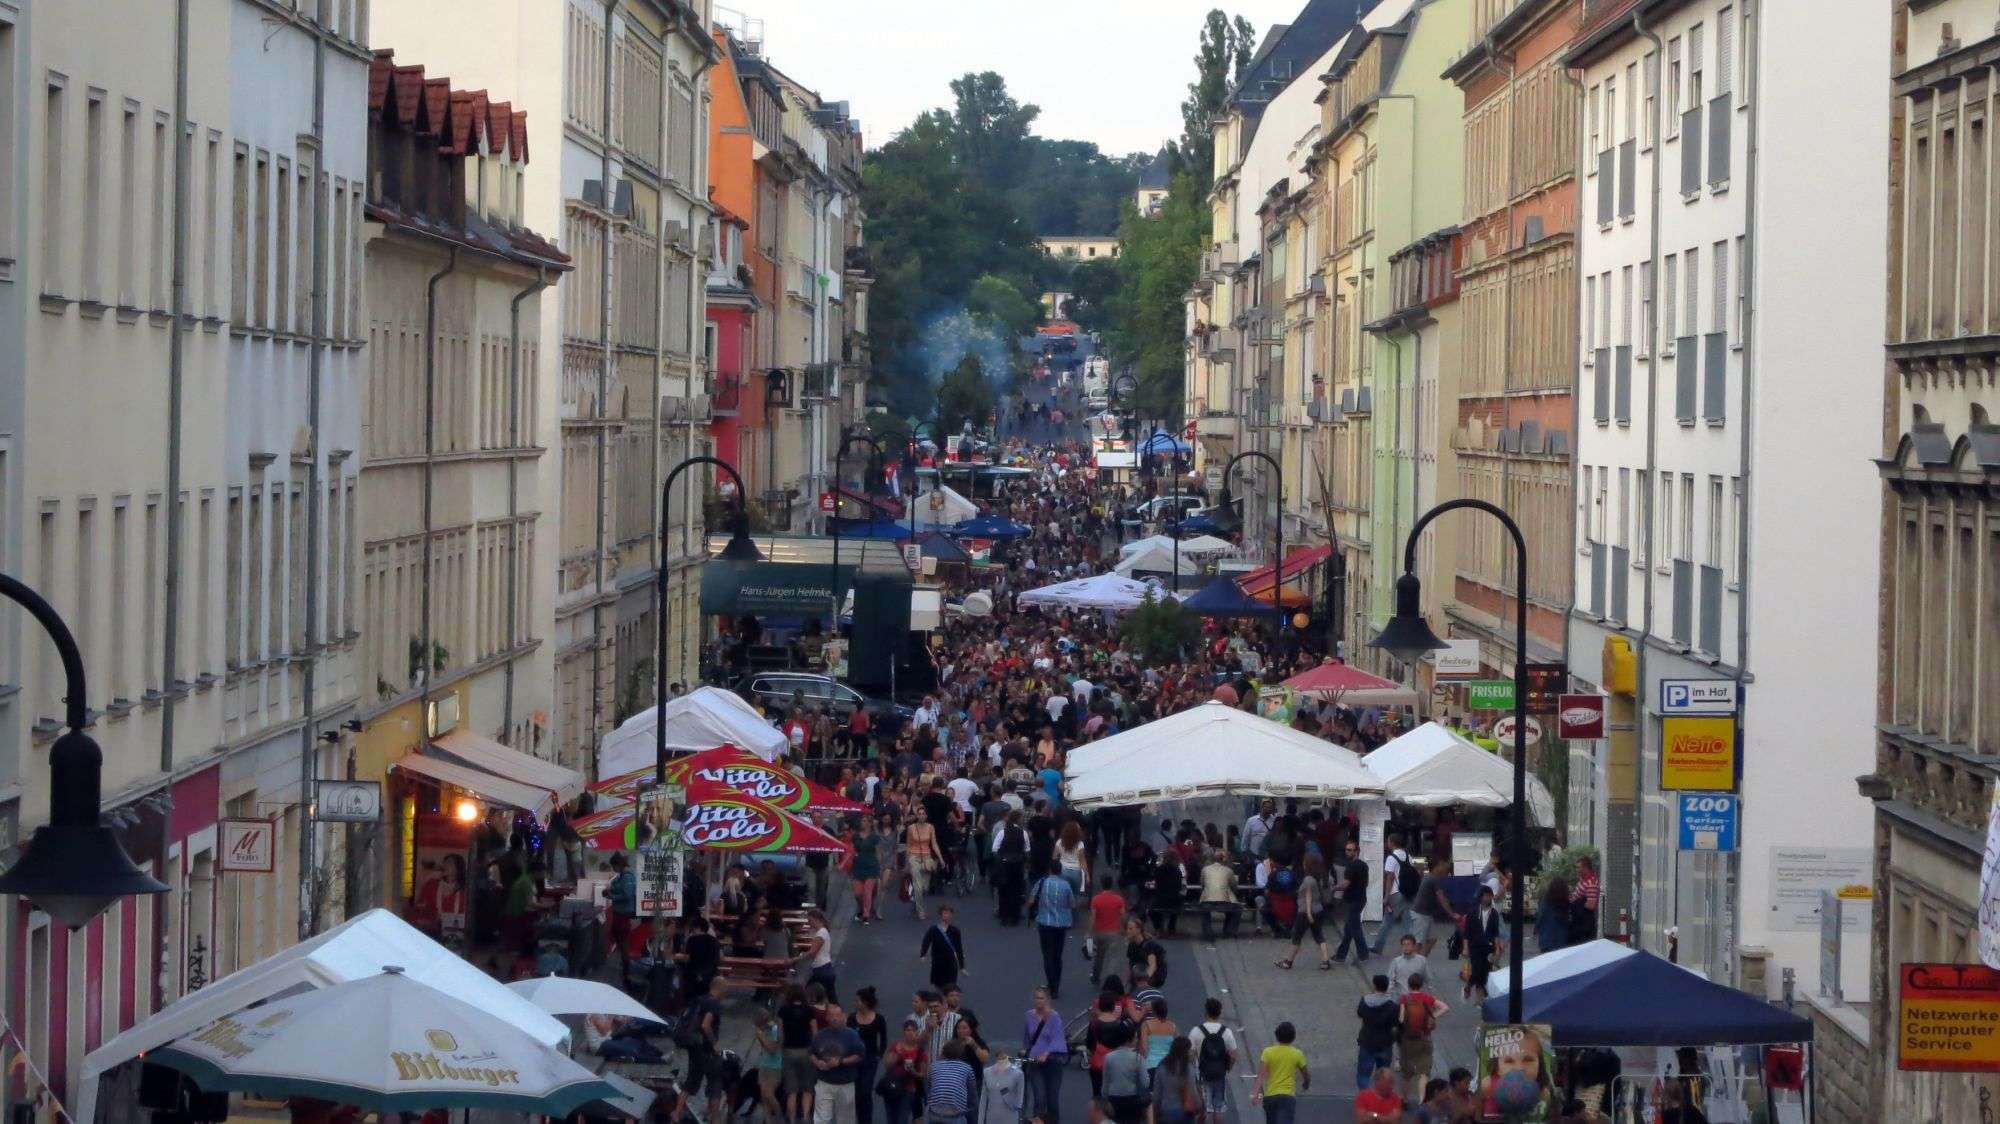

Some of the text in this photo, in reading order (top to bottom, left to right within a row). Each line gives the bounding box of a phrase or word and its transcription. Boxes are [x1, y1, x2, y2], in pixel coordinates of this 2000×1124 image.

[1471, 686, 1513, 699] FRISEUR
[1692, 687, 1705, 697] im
[1709, 686, 1728, 697] Hof
[1672, 735, 1727, 753] Netto
[695, 767, 777, 785] Vita
[1685, 797, 1730, 812] ZOO
[684, 818, 777, 846] Cola
[1907, 1008, 1999, 1021] Netzwerke
[1906, 1022, 1995, 1038] Computer
[1484, 1030, 1525, 1048] HELLO
[1906, 1037, 1972, 1051] Service
[390, 1051, 520, 1087] Bitburger
